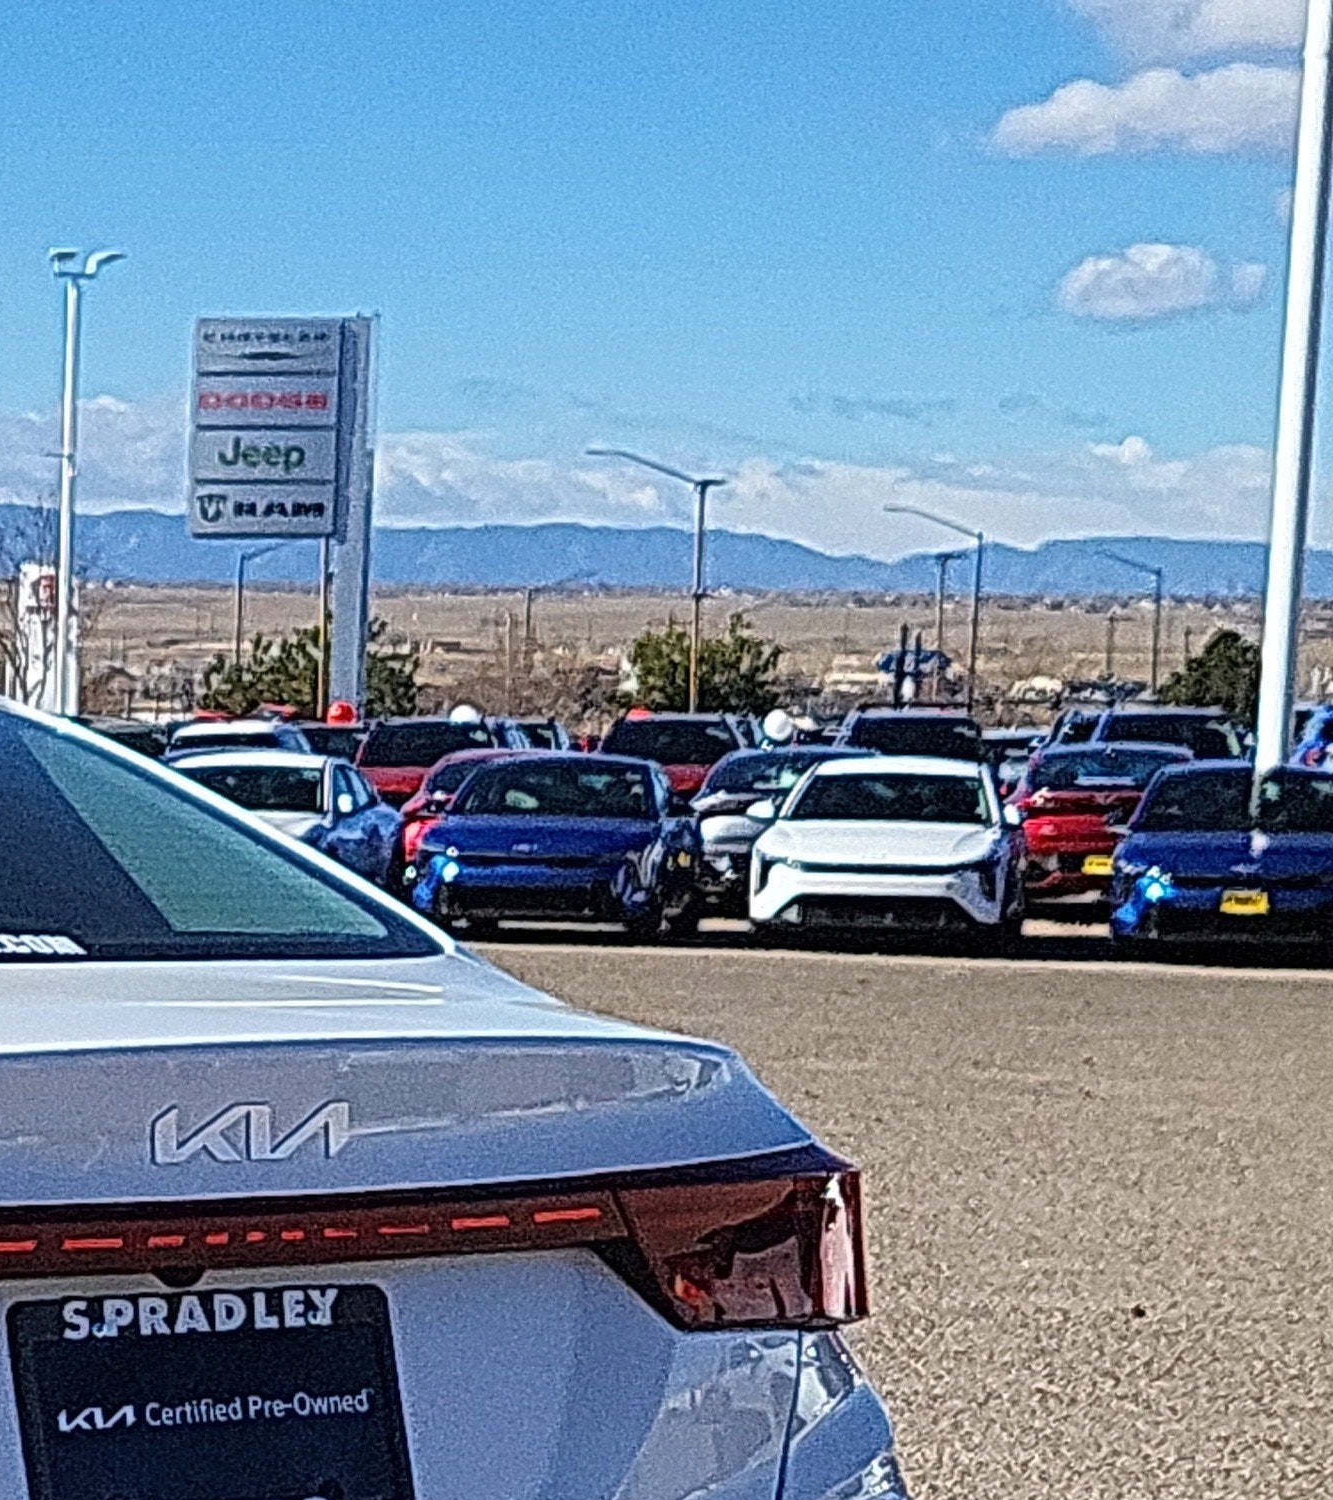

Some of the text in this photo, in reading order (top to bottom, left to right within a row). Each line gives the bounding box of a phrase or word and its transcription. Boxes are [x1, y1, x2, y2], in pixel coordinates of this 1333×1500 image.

[199, 391, 329, 410] DODGE
[217, 435, 306, 472] Jeep
[233, 501, 325, 518] RAM
[61, 1288, 339, 1341] SPRADLEY
[144, 1396, 243, 1428] Certified
[247, 1390, 370, 1421] Pre-Owned
